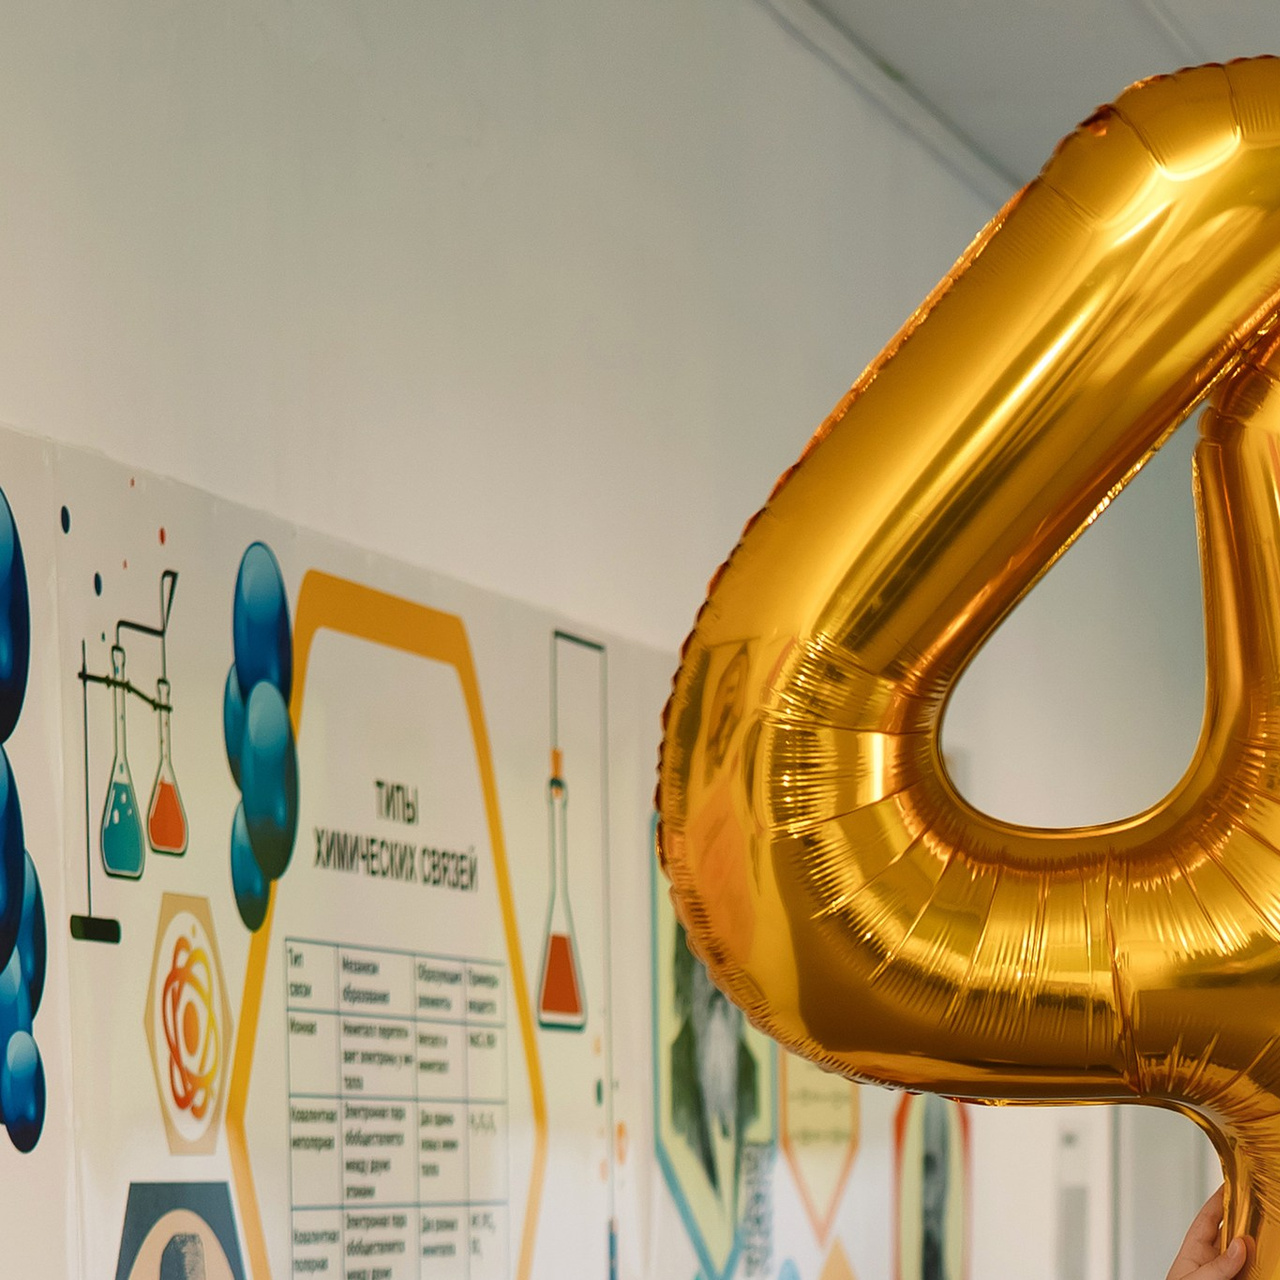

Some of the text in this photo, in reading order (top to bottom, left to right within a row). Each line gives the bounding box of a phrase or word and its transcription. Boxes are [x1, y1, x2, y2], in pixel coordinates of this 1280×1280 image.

[375, 779, 420, 826] ТИПЫ
[312, 826, 479, 893] ХИМИЧЕСКИХ СВЯЗЕЙ
